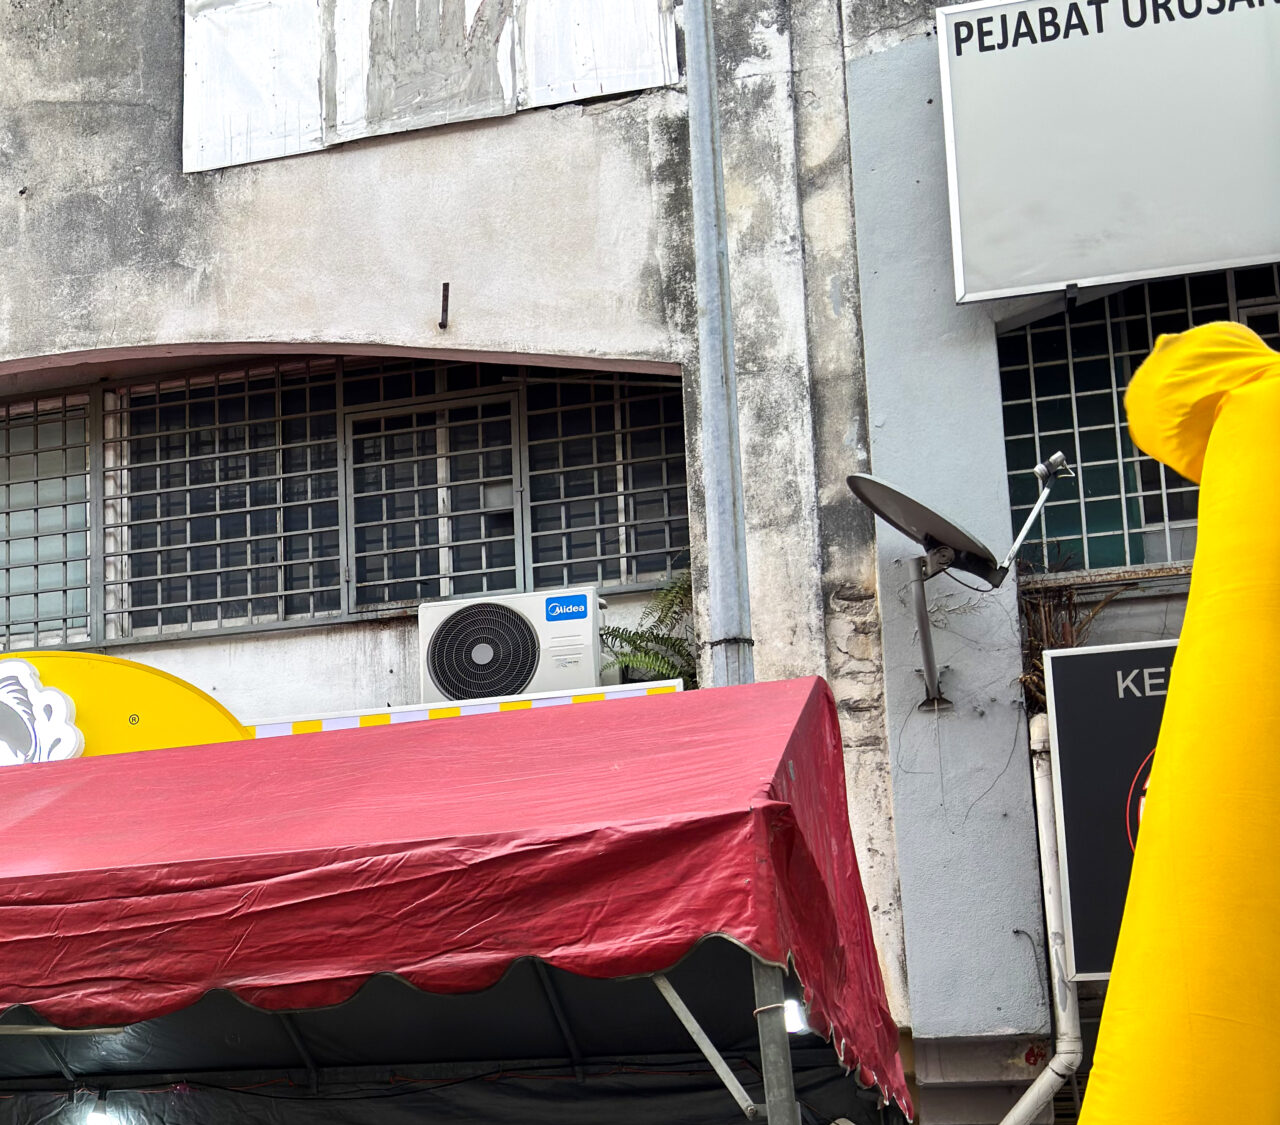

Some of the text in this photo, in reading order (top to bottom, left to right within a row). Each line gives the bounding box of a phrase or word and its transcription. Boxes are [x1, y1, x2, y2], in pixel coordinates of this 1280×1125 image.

[953, 0, 1280, 56] PEJABAT URU
[549, 602, 585, 616] Midea
[1116, 666, 1174, 699] KE
